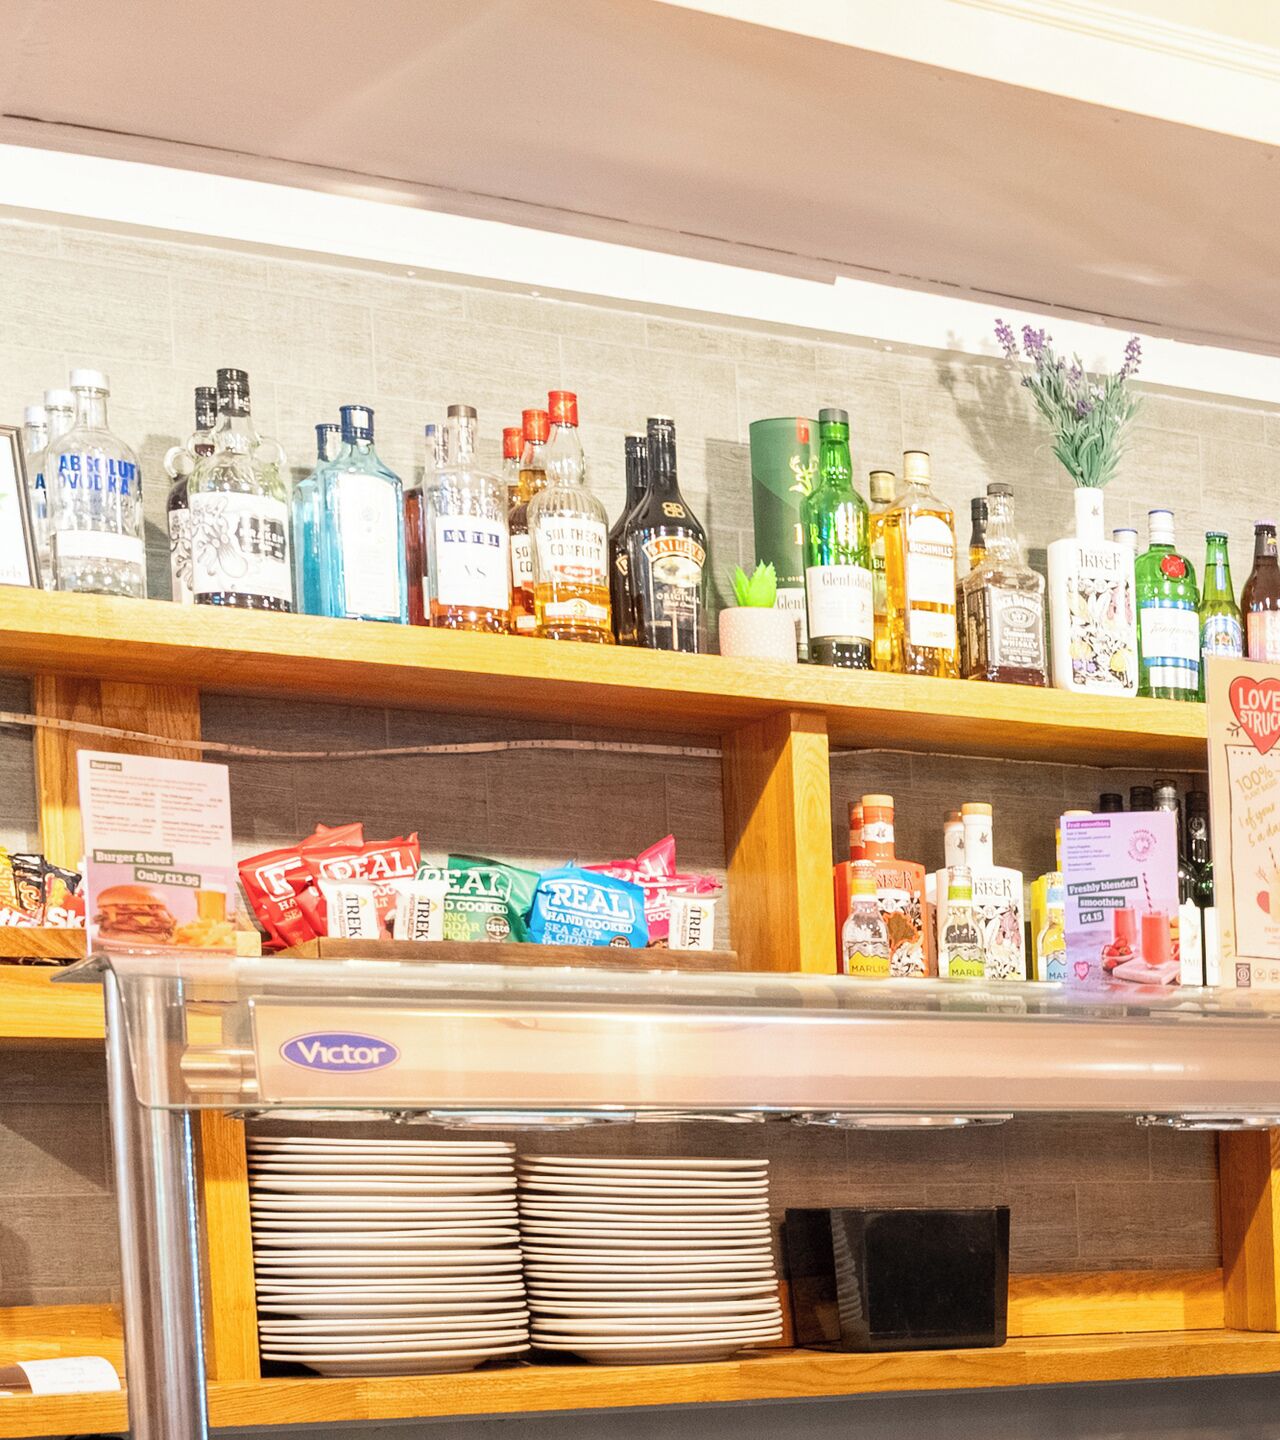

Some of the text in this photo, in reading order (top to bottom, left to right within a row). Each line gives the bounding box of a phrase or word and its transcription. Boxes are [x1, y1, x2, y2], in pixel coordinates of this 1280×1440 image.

[1236, 765, 1274, 793] 100%
[95, 851, 171, 864] Burger & beer
[136, 870, 164, 883] Only
[1068, 879, 1137, 895] Freshly blended
[457, 901, 509, 914] COOKED
[552, 883, 631, 919] REAL
[1080, 898, 1124, 907] smoothies
[346, 895, 363, 938] TREK
[415, 899, 431, 939] TREK
[549, 911, 634, 935] HAND COOKED
[545, 922, 600, 940] SEA SALT
[688, 907, 701, 947] TREK
[557, 932, 594, 947] CIDER
[951, 969, 985, 978] MARLIS
[297, 1041, 386, 1064] Victor
